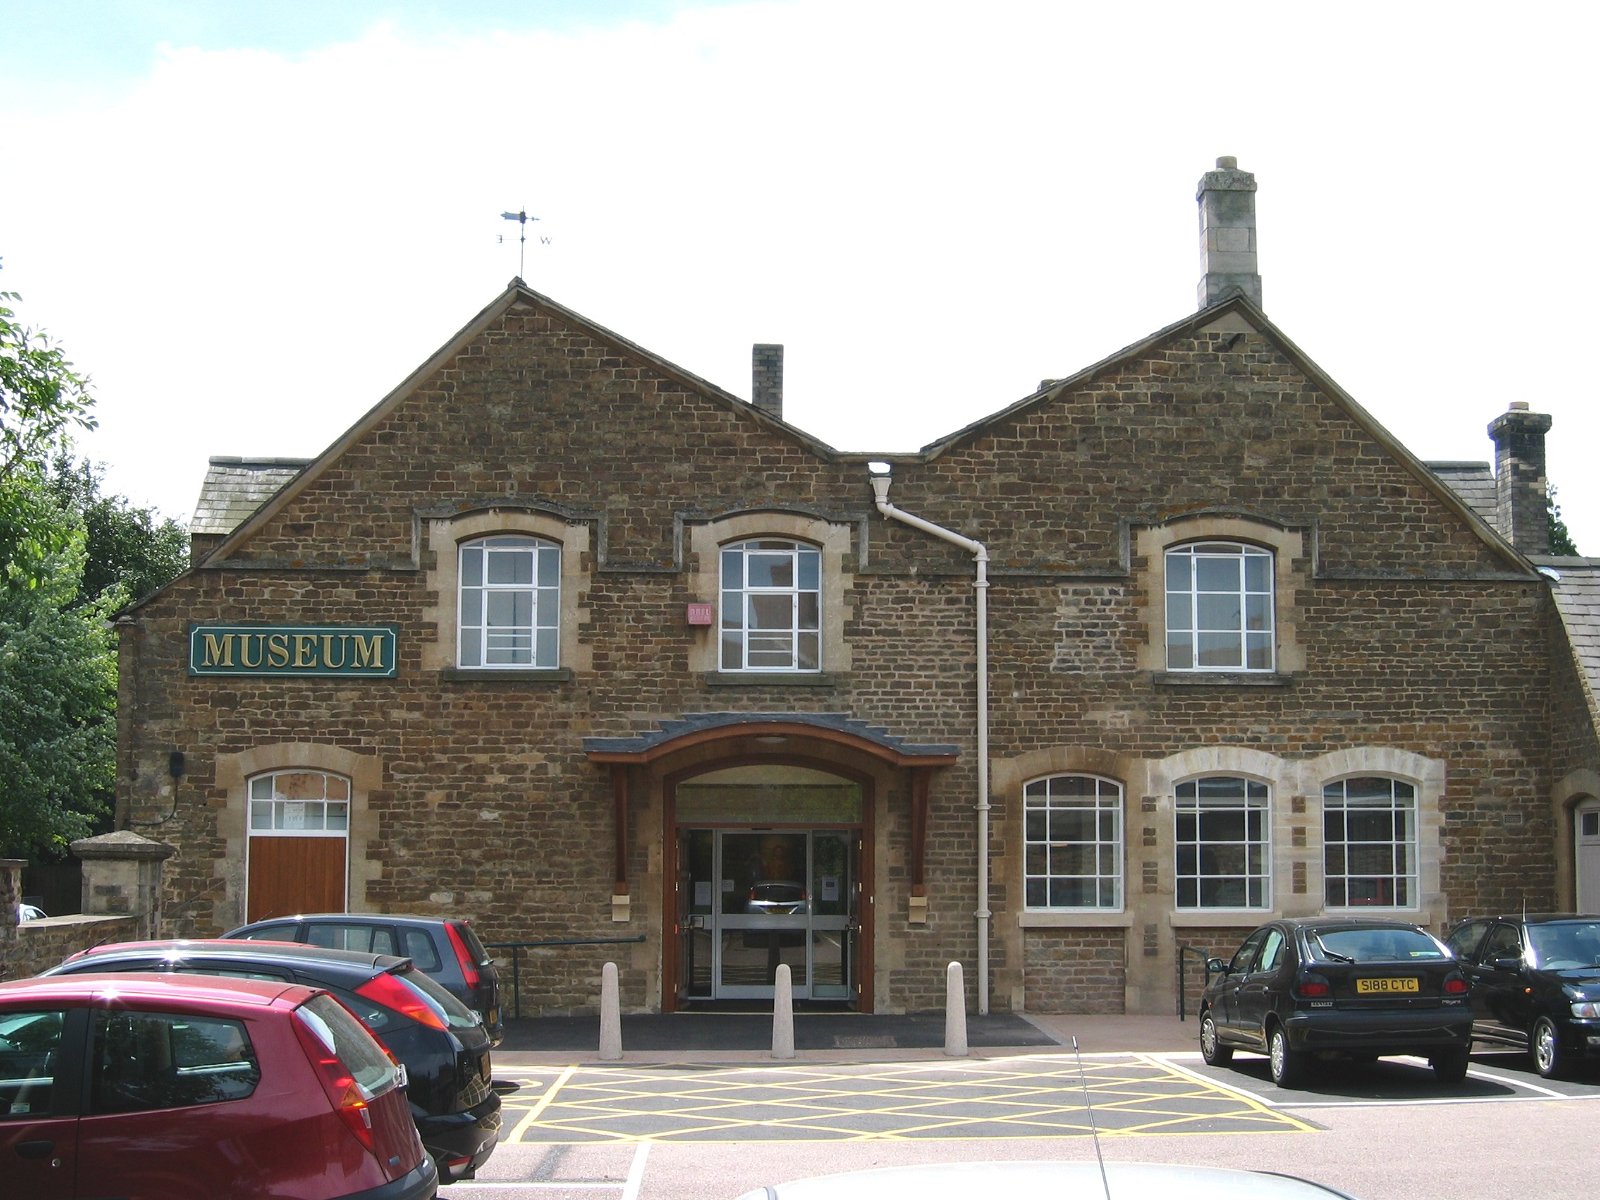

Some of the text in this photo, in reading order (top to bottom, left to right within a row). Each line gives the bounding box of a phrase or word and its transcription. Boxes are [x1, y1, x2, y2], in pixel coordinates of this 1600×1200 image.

[201, 633, 385, 668] MUSEUM
[1361, 979, 1415, 991] S188 CTC
